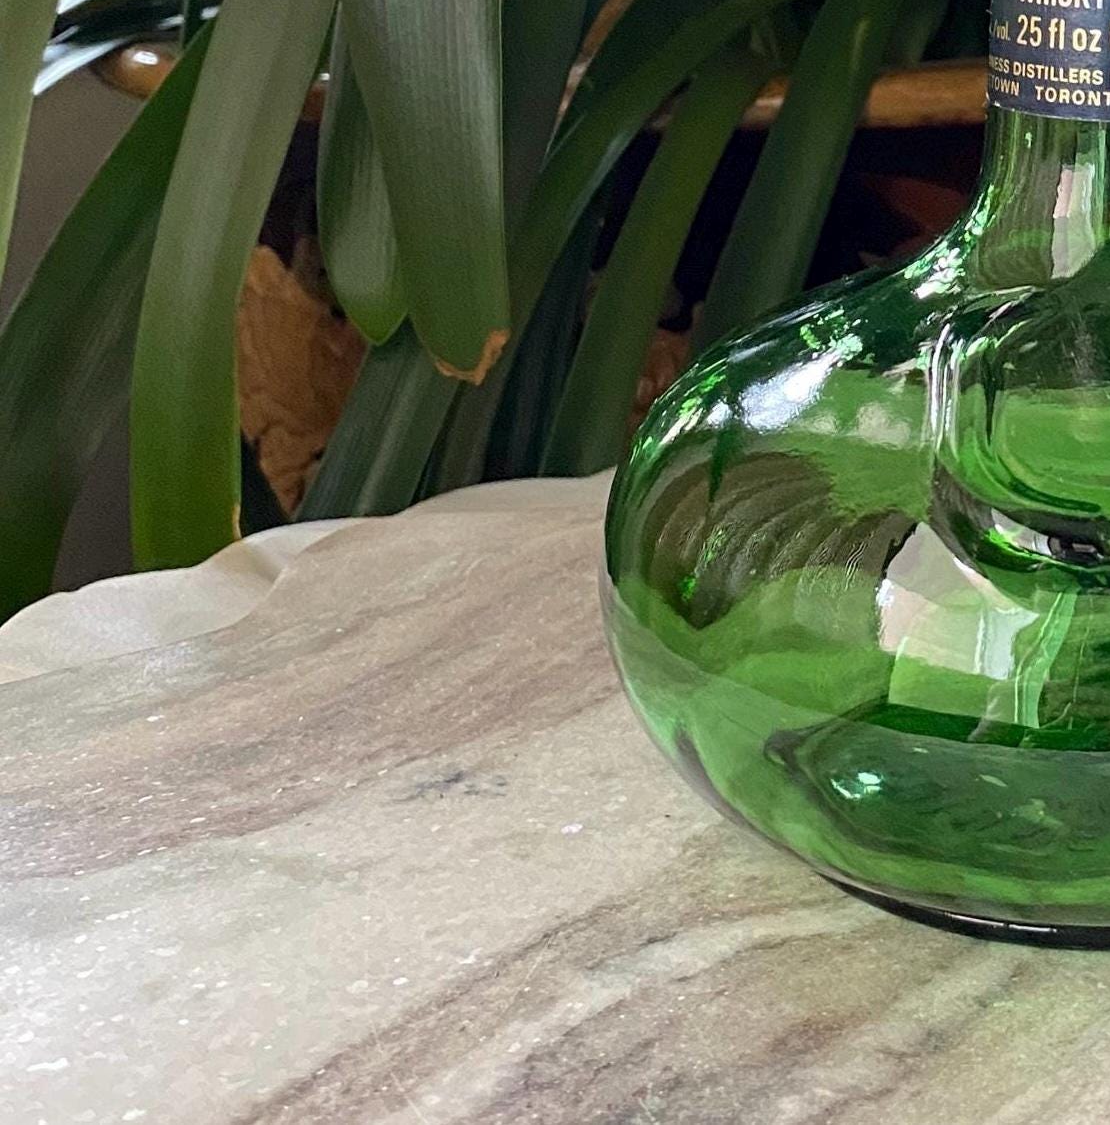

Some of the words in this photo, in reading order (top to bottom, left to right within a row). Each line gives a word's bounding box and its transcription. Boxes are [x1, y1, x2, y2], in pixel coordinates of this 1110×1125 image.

[1016, 14, 1042, 47] 25
[1048, 17, 1066, 51] fl
[1072, 26, 1102, 53] oz
[1012, 61, 1104, 86] DISTILLERS
